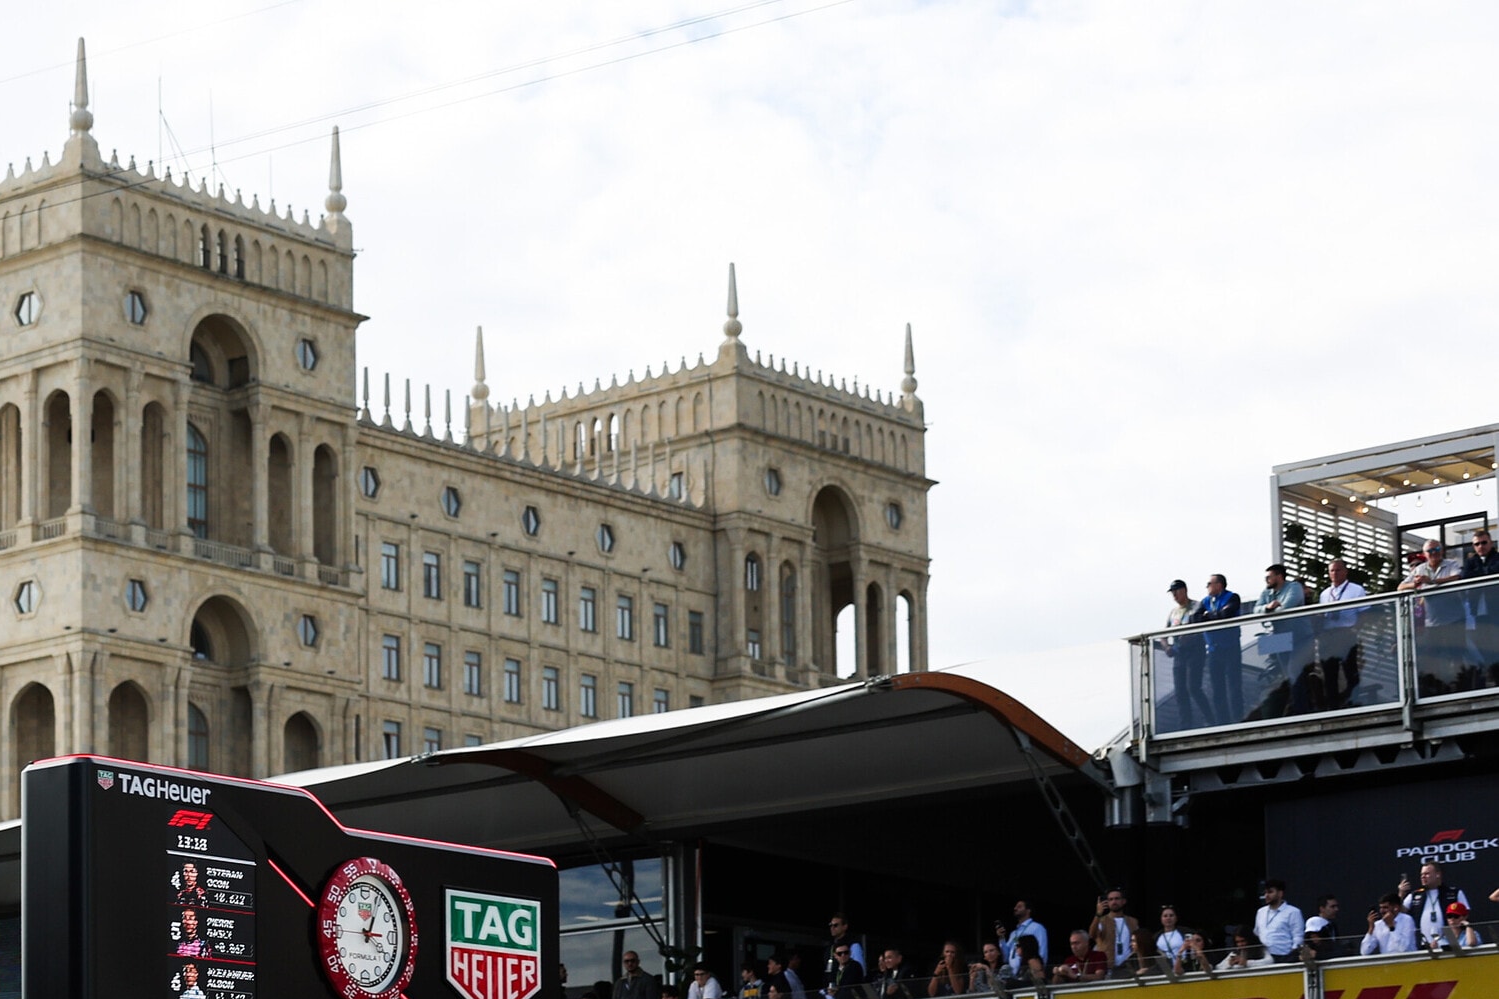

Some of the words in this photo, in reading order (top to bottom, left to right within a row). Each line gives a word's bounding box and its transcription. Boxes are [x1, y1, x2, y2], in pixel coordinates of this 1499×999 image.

[1396, 838, 1499, 858] PADDOCK
[1420, 851, 1475, 864] CLUB
[170, 921, 182, 941] 5
[454, 901, 533, 946] TAG
